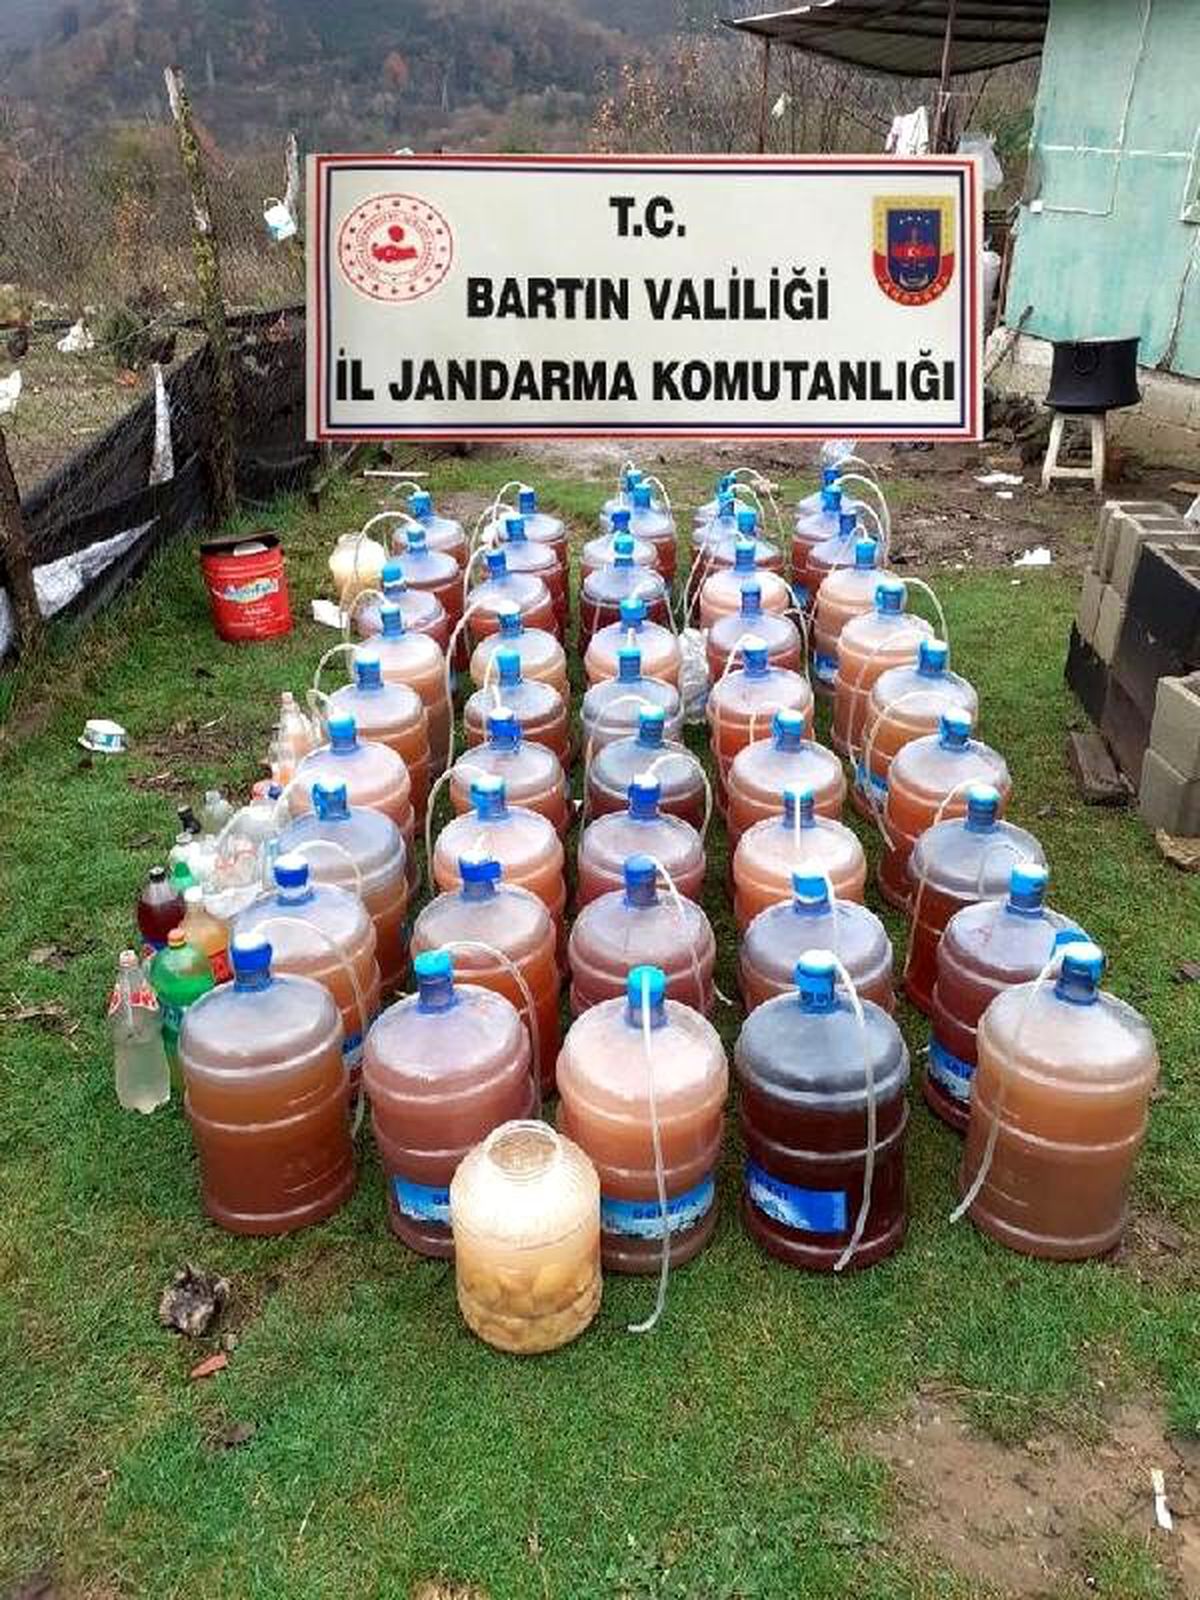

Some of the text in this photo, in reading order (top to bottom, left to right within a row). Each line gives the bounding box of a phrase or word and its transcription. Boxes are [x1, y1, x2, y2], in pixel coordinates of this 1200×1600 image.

[609, 196, 686, 238] T.C.
[466, 266, 829, 321] BARTIN VALİLİĞİ
[335, 347, 956, 402] İL JANDARMA KOMUTANLIĞI
